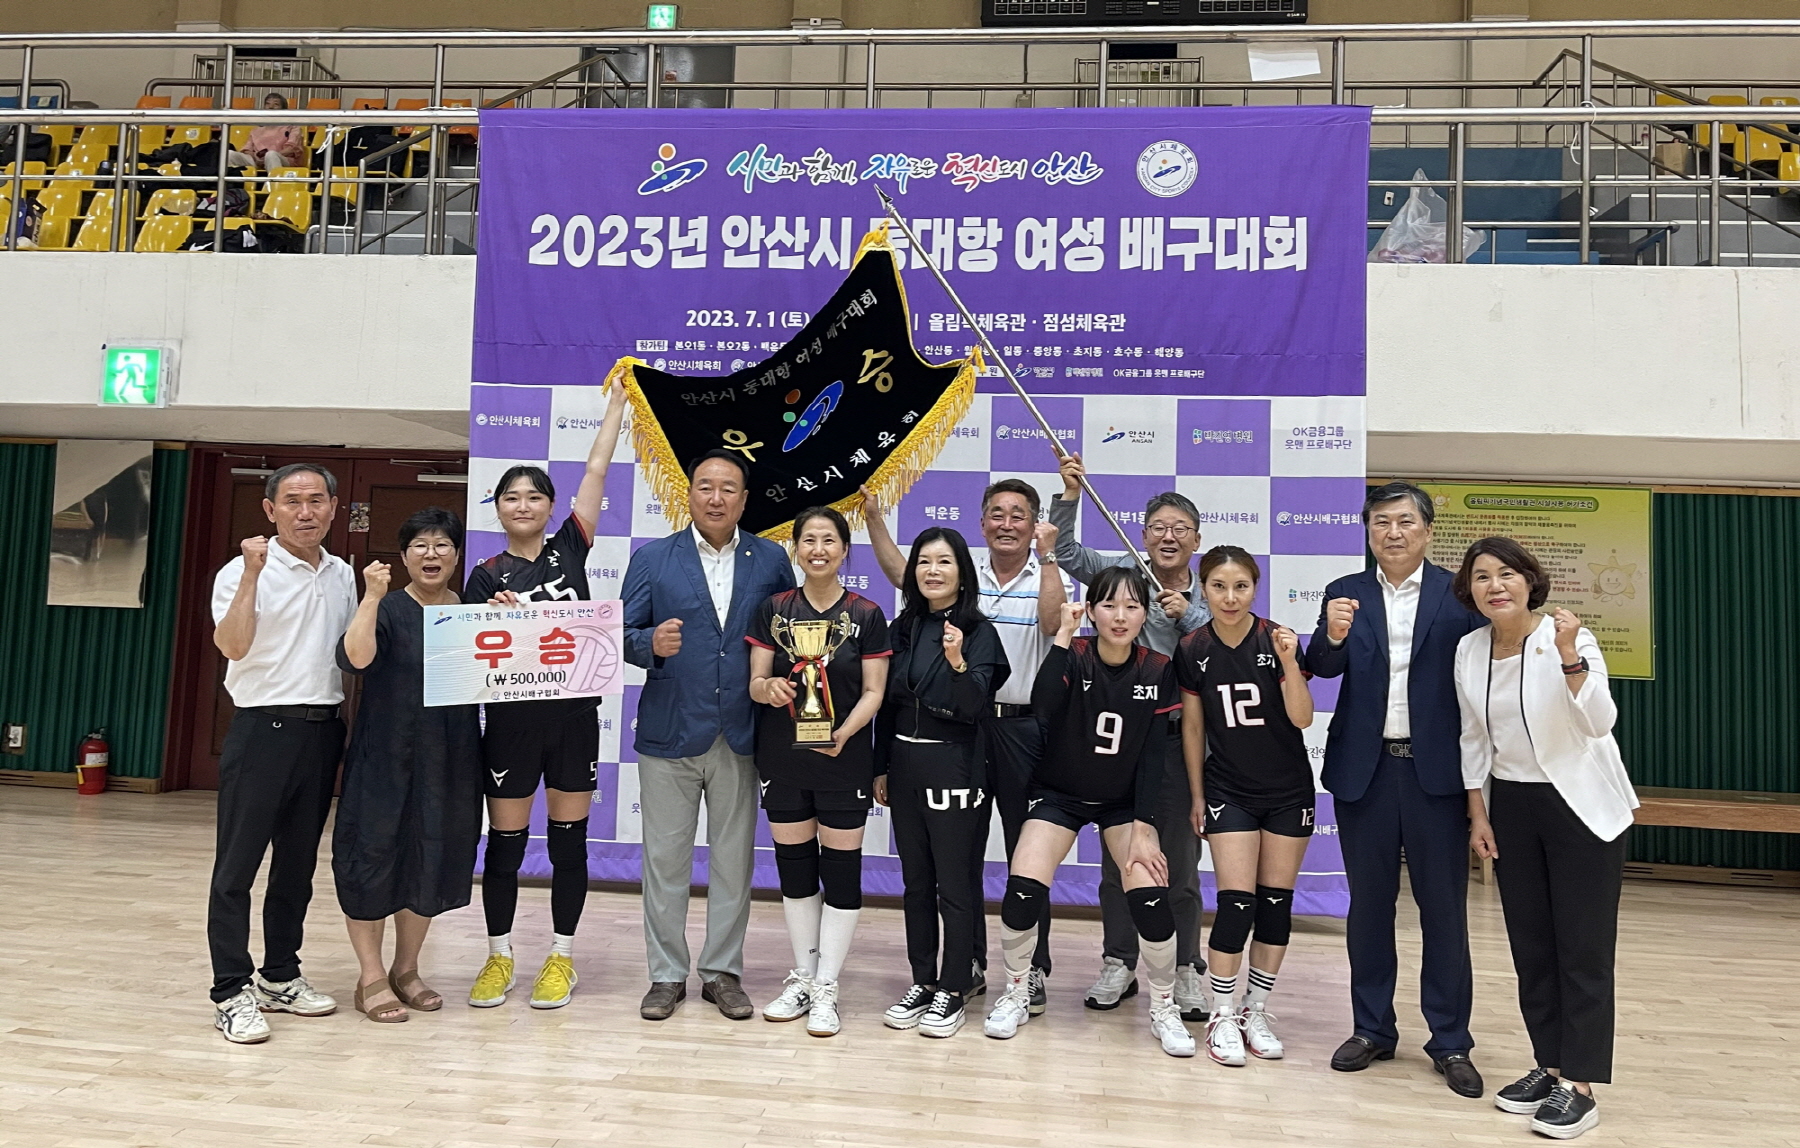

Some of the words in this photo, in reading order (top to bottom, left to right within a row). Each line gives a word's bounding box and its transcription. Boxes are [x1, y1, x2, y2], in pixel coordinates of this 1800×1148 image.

[727, 143, 804, 193] 시민과
[802, 147, 857, 185] 함께,
[861, 153, 937, 194] 자유로운
[942, 152, 1028, 192] 혁신도시
[1031, 151, 1104, 185] 안산
[528, 213, 708, 269] 2023년
[721, 215, 852, 270] 안산시
[1014, 216, 1105, 272] 여성
[1119, 215, 1308, 272] 배구대회
[686, 309, 740, 328] 2023.
[745, 311, 762, 328] 7.
[767, 311, 776, 327] 1
[1043, 312, 1126, 332] 점섬체육관
[717, 341, 750, 352] 본오2동
[924, 345, 953, 356] 안산동
[1073, 347, 1103, 358] 초지동
[1113, 347, 1143, 358] 호수동
[1154, 348, 1185, 359] 해양동
[668, 359, 722, 371] 안산시체육회
[742, 362, 792, 395] 동대항
[795, 338, 824, 365] 여성
[489, 414, 541, 427] 안산시체육회
[1128, 430, 1155, 439] 안산시
[1292, 426, 1344, 437] OK금융그룹
[1306, 440, 1352, 450] 프로배구단
[925, 505, 960, 520] 백운동
[1200, 511, 1259, 524] 안산시체육회
[1293, 513, 1360, 525] 안산시배구협회
[457, 613, 482, 622] 시민과
[506, 610, 539, 620] 자유로운
[542, 609, 574, 619] 혁신도시
[577, 608, 595, 618] 안산
[503, 688, 560, 700] 안산시배구협회
[1132, 684, 1158, 700] 초지
[1217, 683, 1265, 728] 12
[1094, 711, 1123, 755] 9
[1301, 808, 1314, 826] 12
